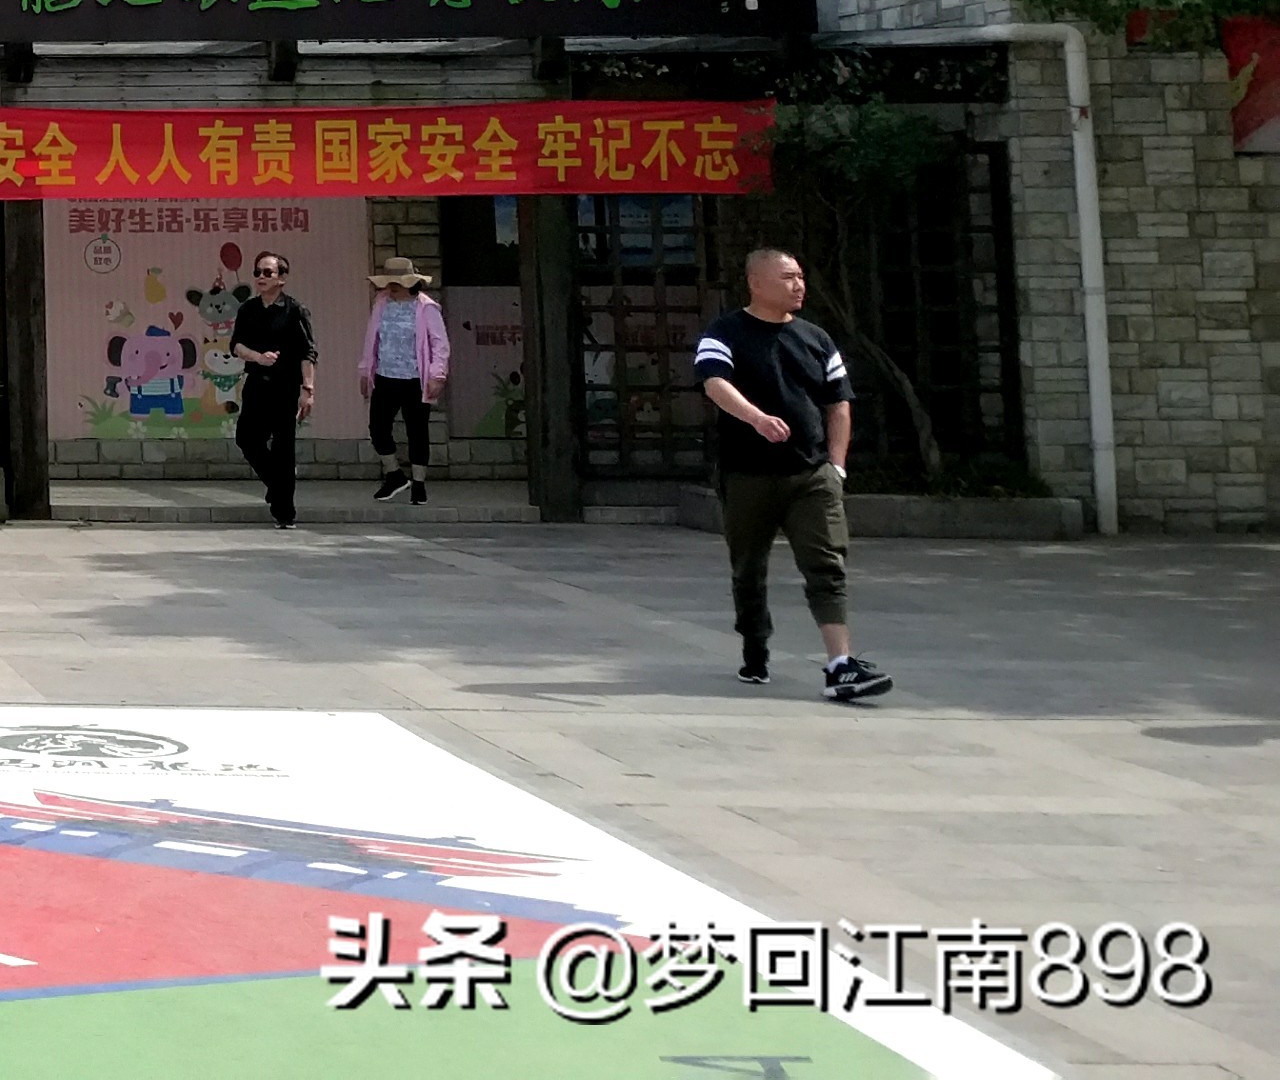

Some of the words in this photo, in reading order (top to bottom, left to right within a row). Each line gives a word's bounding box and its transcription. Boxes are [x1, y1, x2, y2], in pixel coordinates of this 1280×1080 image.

[95, 119, 295, 187] 人人有责
[315, 117, 518, 185] 国家安全
[537, 115, 739, 183] 牢记不忘
